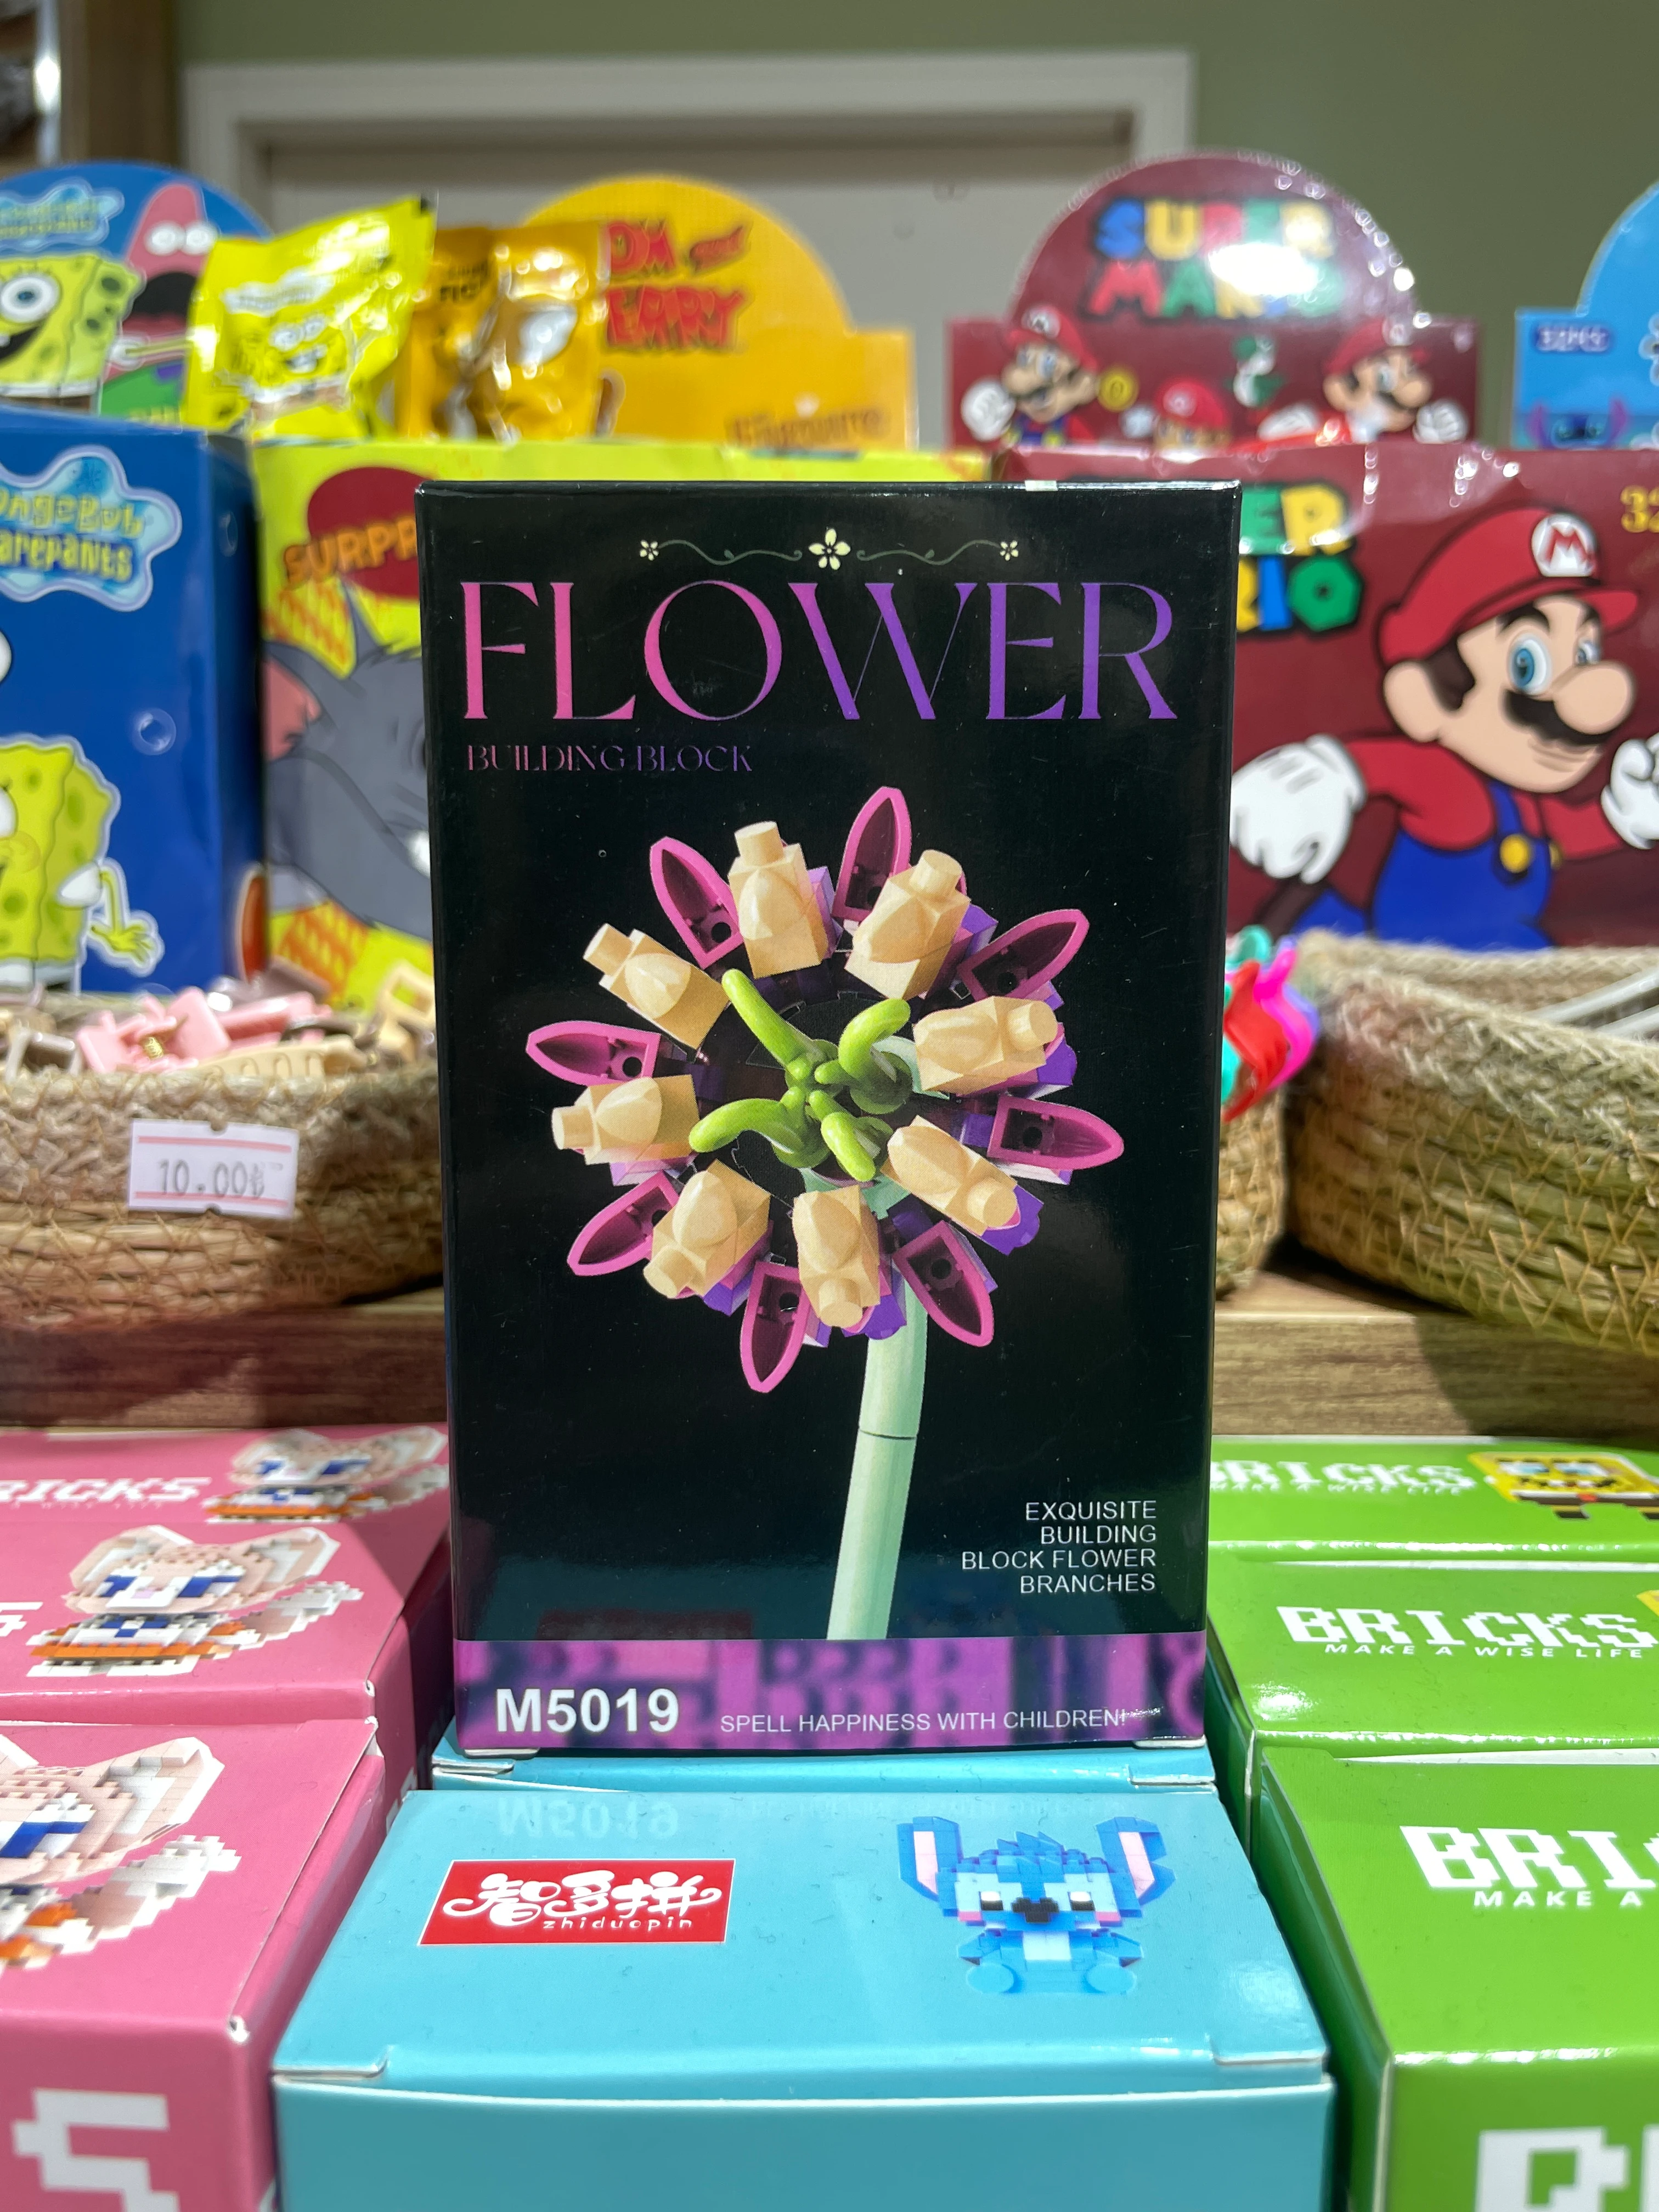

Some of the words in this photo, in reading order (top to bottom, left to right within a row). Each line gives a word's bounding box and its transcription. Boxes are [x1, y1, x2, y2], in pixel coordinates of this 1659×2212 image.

[461, 579, 1178, 721] FLOWER
[467, 744, 625, 771] BUILDING
[637, 745, 753, 771] BLOCK
[1025, 1500, 1157, 1521] EXQUISITE
[1041, 1525, 1156, 1545] BUILDING
[962, 1550, 1045, 1570] BLOCK
[1052, 1548, 1156, 1568] FLOWER
[1020, 1573, 1155, 1594] BRANCHES
[1276, 1606, 1659, 1648] BRICKS
[1324, 1644, 1415, 1655] MAKE
[1435, 1646, 1453, 1656] A
[1474, 1647, 1554, 1657] WISE
[1576, 1647, 1642, 1658] LIFE
[496, 1688, 680, 1733] M5019
[720, 1714, 792, 1733] SPELL
[799, 1713, 931, 1732] HAPPINESS
[938, 1712, 995, 1730] WITH
[1003, 1708, 1126, 1729] CHILDREN!
[1399, 1825, 1659, 1888] BRI
[1474, 1891, 1592, 1907] MAKE
[1620, 1891, 1643, 1907] A
[543, 1916, 693, 1932] zhiduopin
